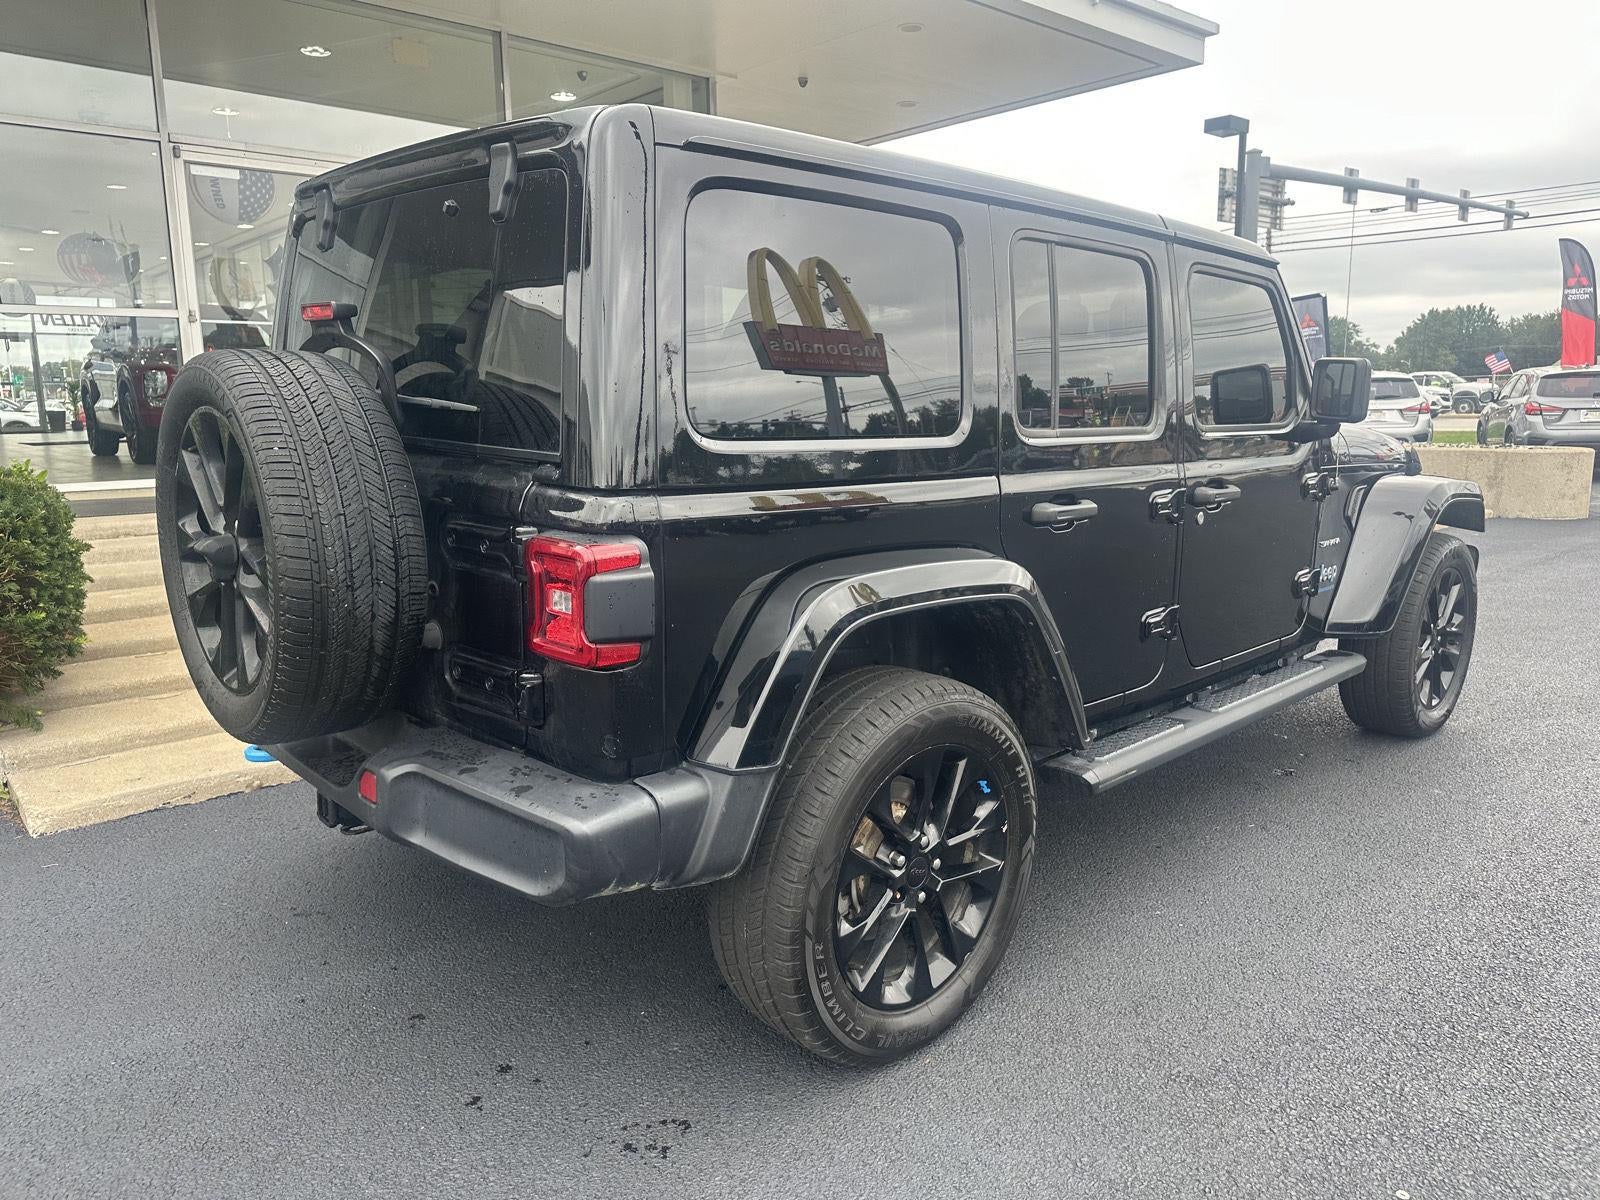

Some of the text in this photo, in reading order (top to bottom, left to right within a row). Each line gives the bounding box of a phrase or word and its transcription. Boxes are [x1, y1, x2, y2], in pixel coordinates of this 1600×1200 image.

[208, 174, 227, 210] WNED
[957, 712, 1018, 757] SUMMIT
[814, 940, 867, 1042] CLIMBER
